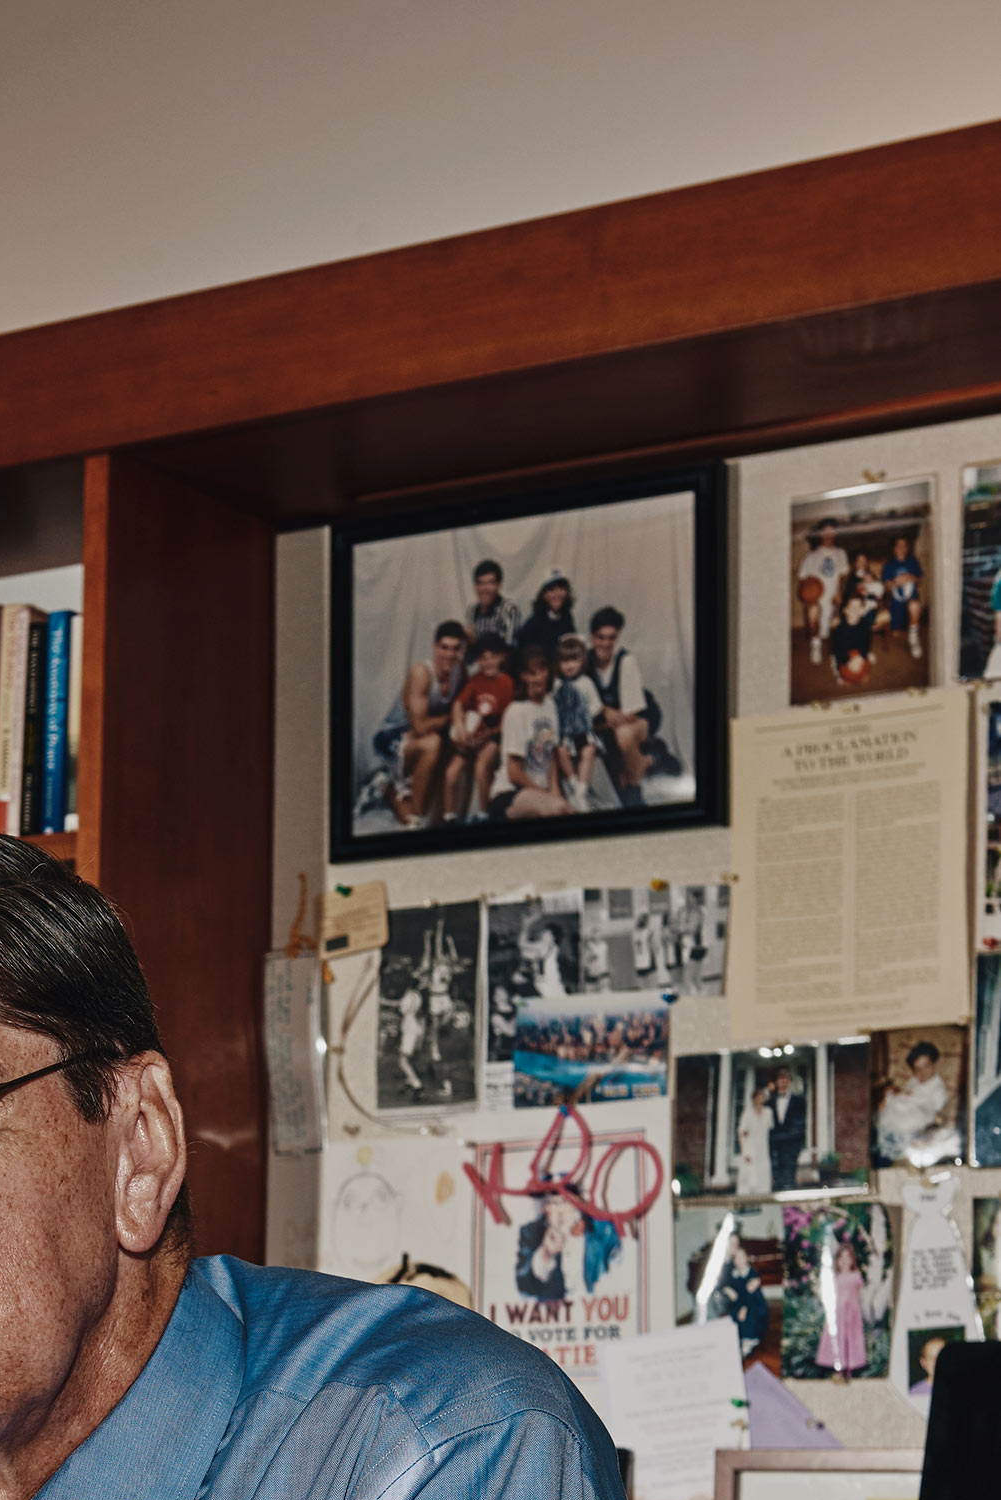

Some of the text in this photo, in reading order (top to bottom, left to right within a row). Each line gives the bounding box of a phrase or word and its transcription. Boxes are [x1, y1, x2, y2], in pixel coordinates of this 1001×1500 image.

[819, 753, 848, 770] THE
[505, 1299, 575, 1325] WANT
[582, 1294, 630, 1322] YOU
[528, 1326, 578, 1342] VOTE
[583, 1325, 622, 1341] FOR
